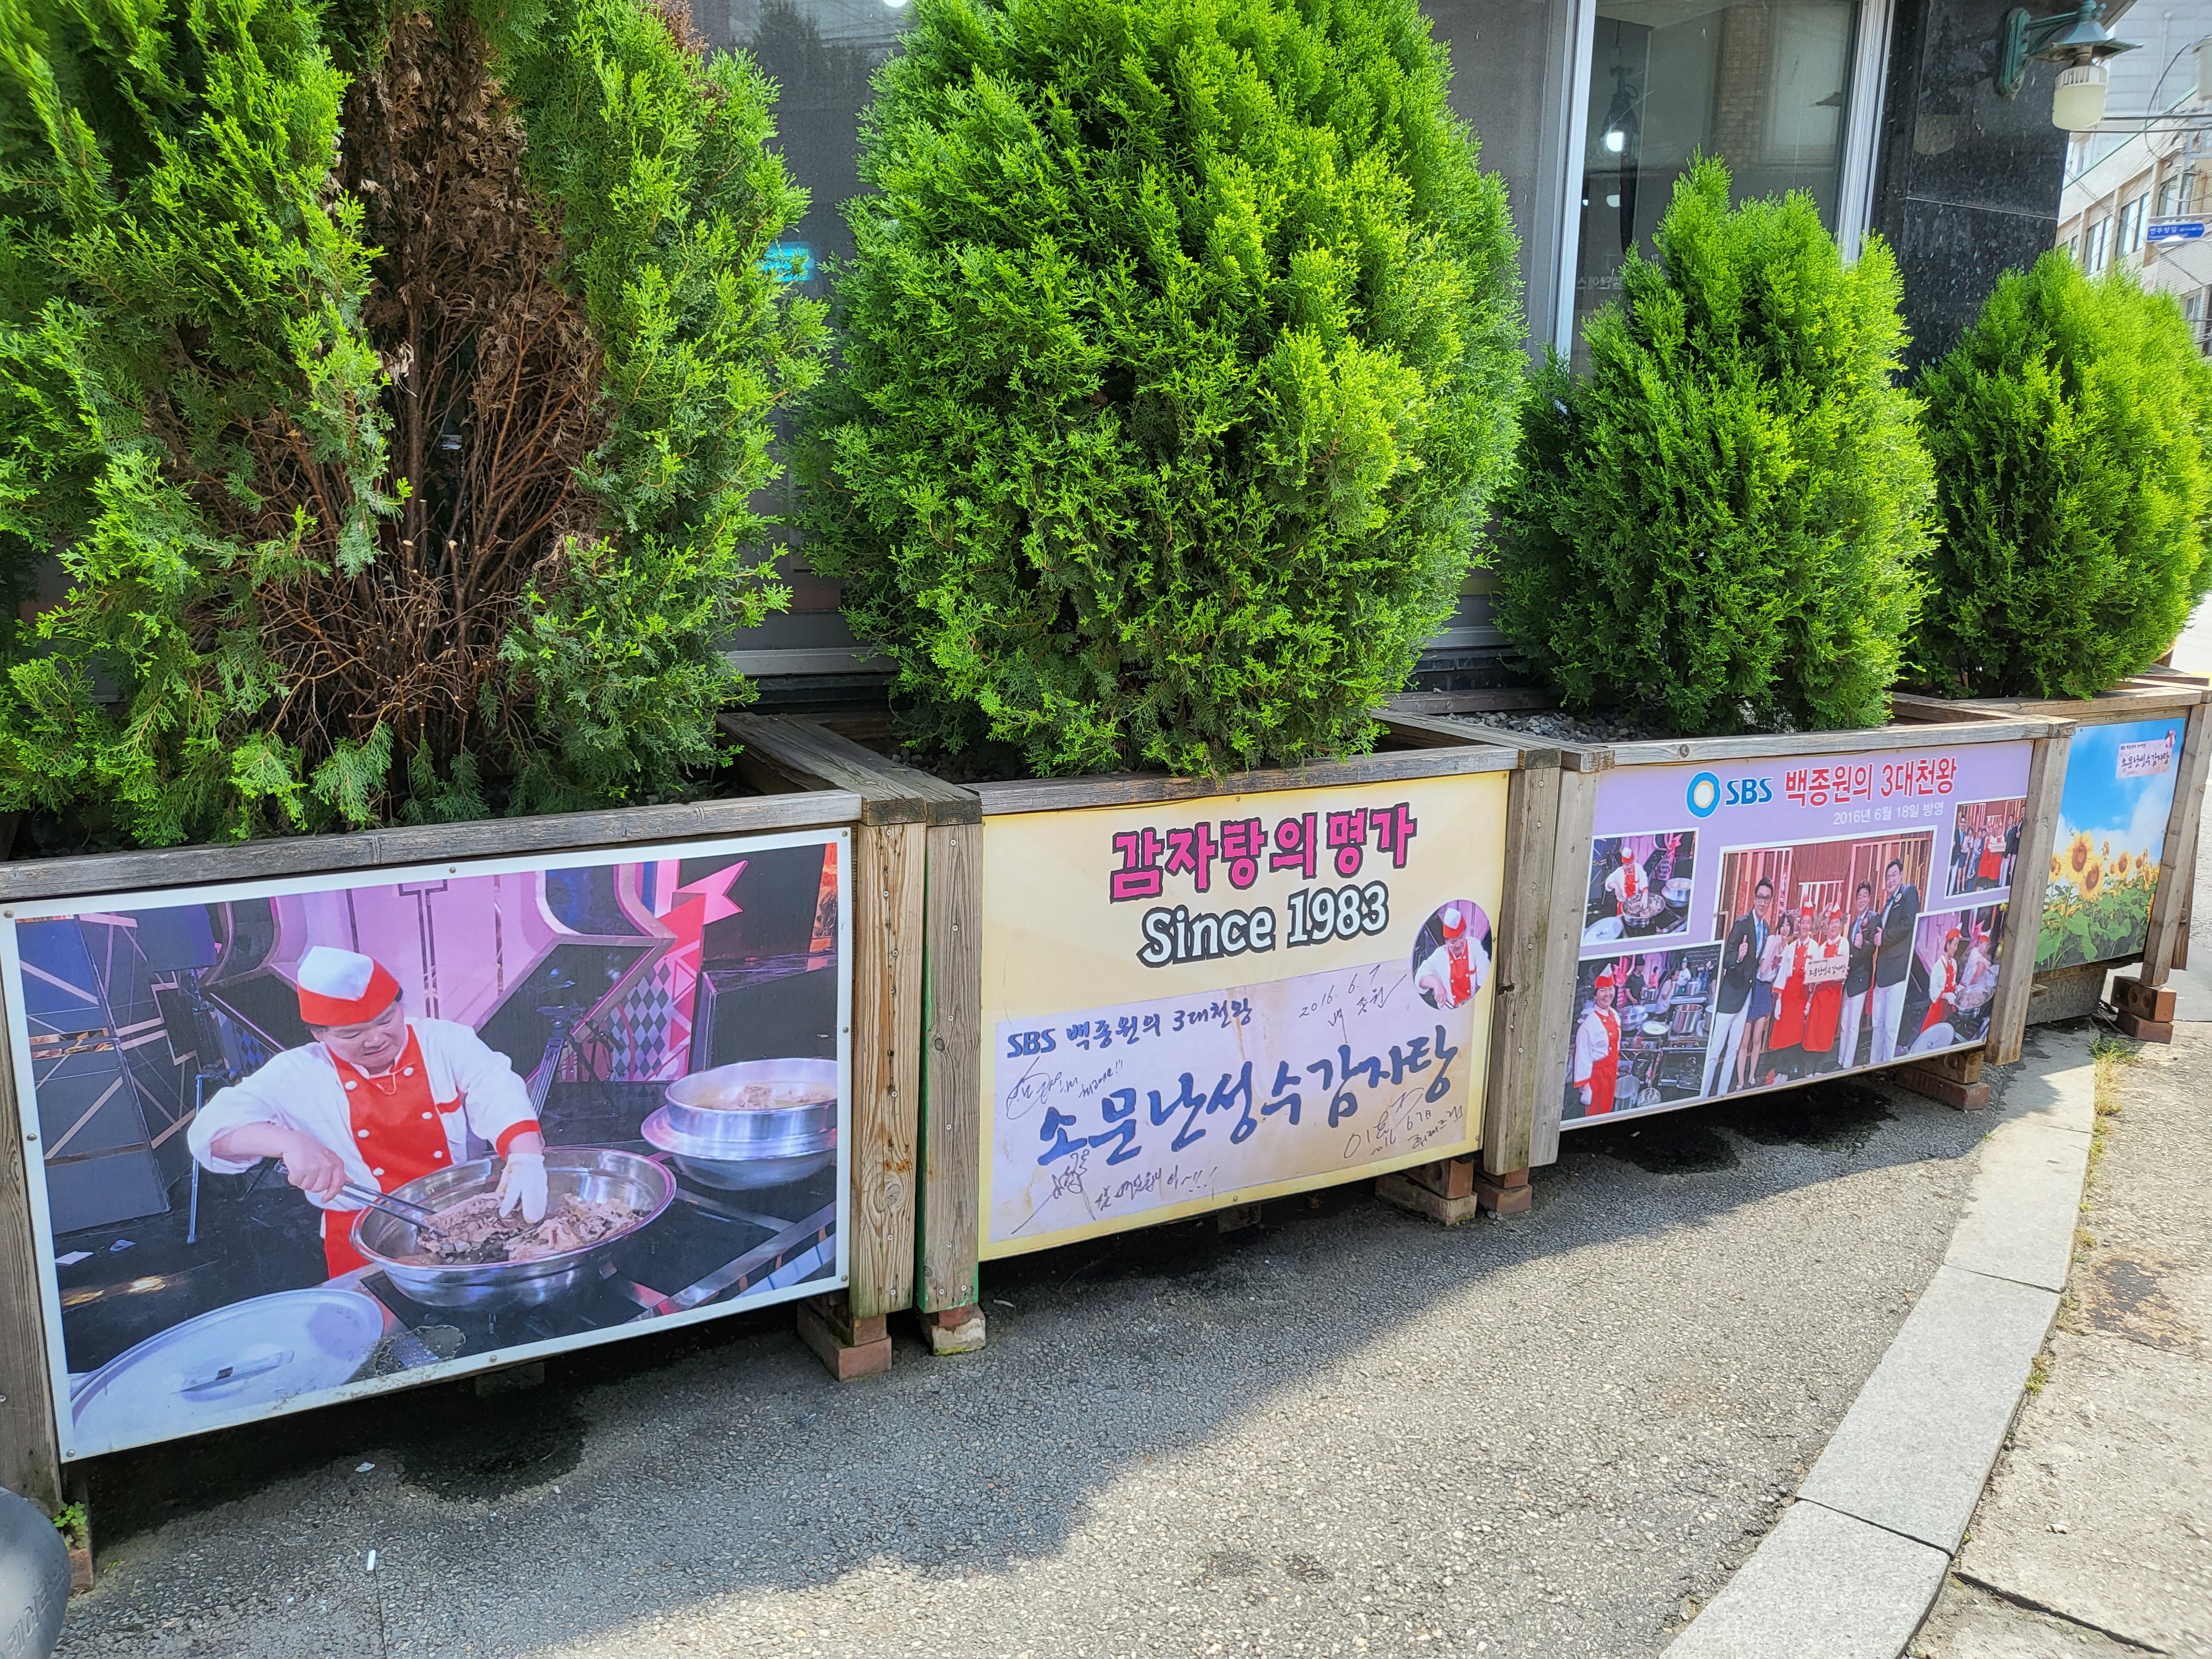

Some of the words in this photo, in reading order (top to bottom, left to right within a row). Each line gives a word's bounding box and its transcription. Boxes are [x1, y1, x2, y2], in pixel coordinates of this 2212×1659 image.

[1725, 778, 1773, 806] SBS
[1785, 763, 1873, 807] 백종원의
[1880, 757, 1957, 798] 3대천왕
[1833, 810, 1871, 825] 2016년
[1874, 806, 1892, 821] 6월
[1896, 804, 1919, 818] 18일
[1923, 801, 1944, 817] 방영
[1136, 905, 1276, 967] Since
[1286, 880, 1389, 948] 1983
[1007, 1029, 1056, 1058] SBS
[1066, 1014, 1161, 1050] 백종원의
[1172, 998, 1253, 1031] 3대천왕
